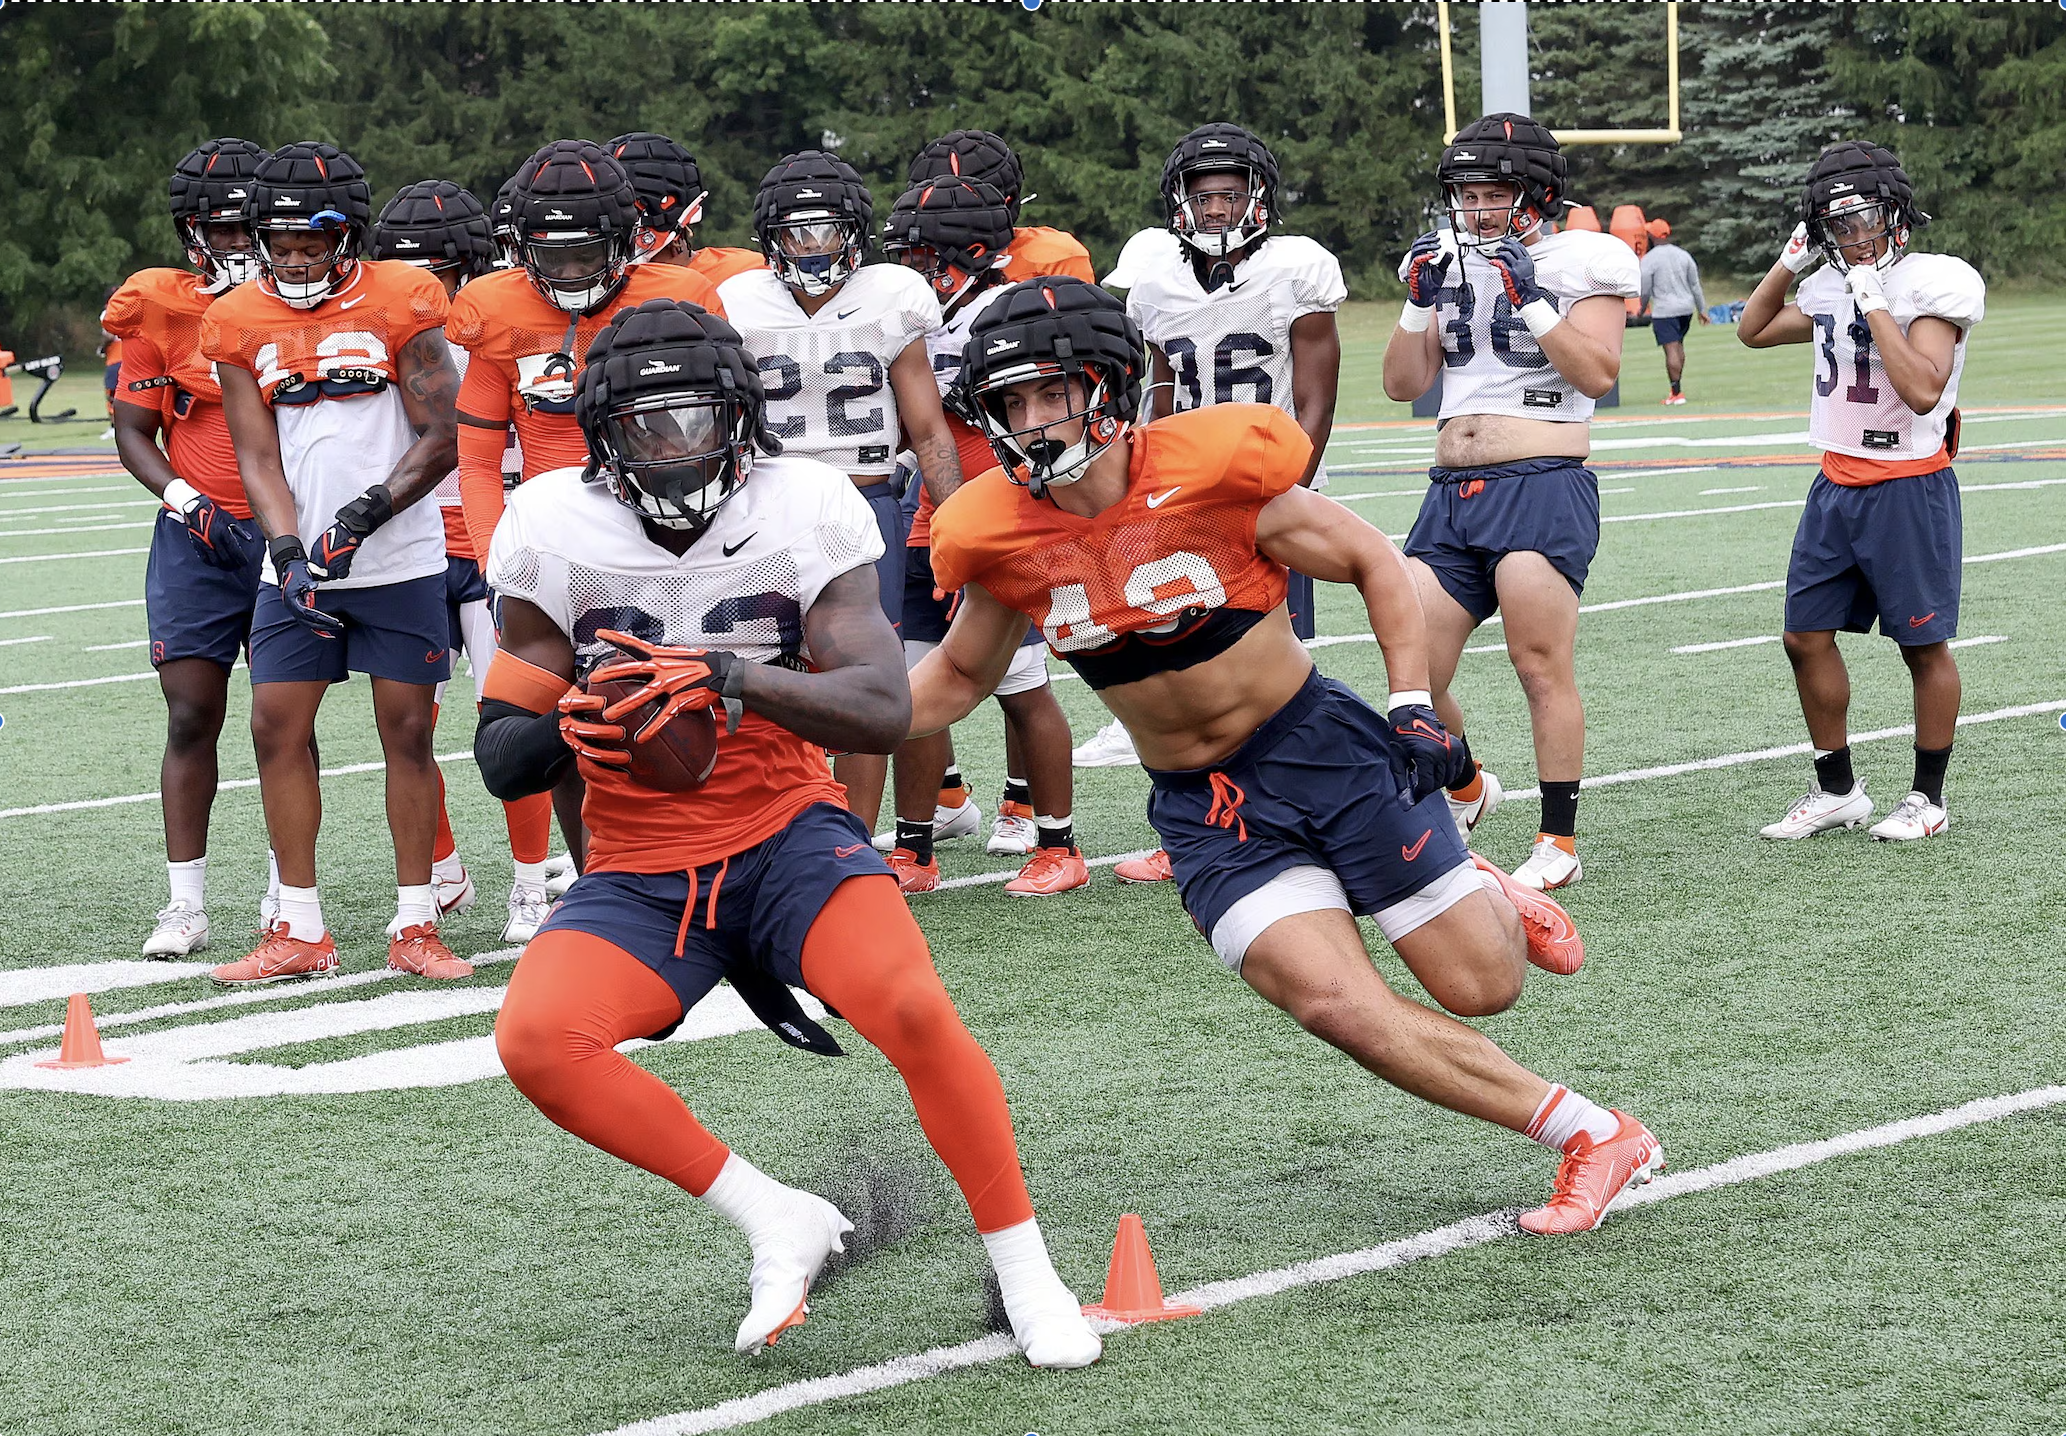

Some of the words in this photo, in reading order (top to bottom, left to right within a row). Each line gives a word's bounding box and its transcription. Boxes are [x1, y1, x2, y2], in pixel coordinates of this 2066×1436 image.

[987, 340, 1020, 356] GUARDIAN
[640, 364, 681, 376] GUARDIAN
[757, 351, 884, 438] 22
